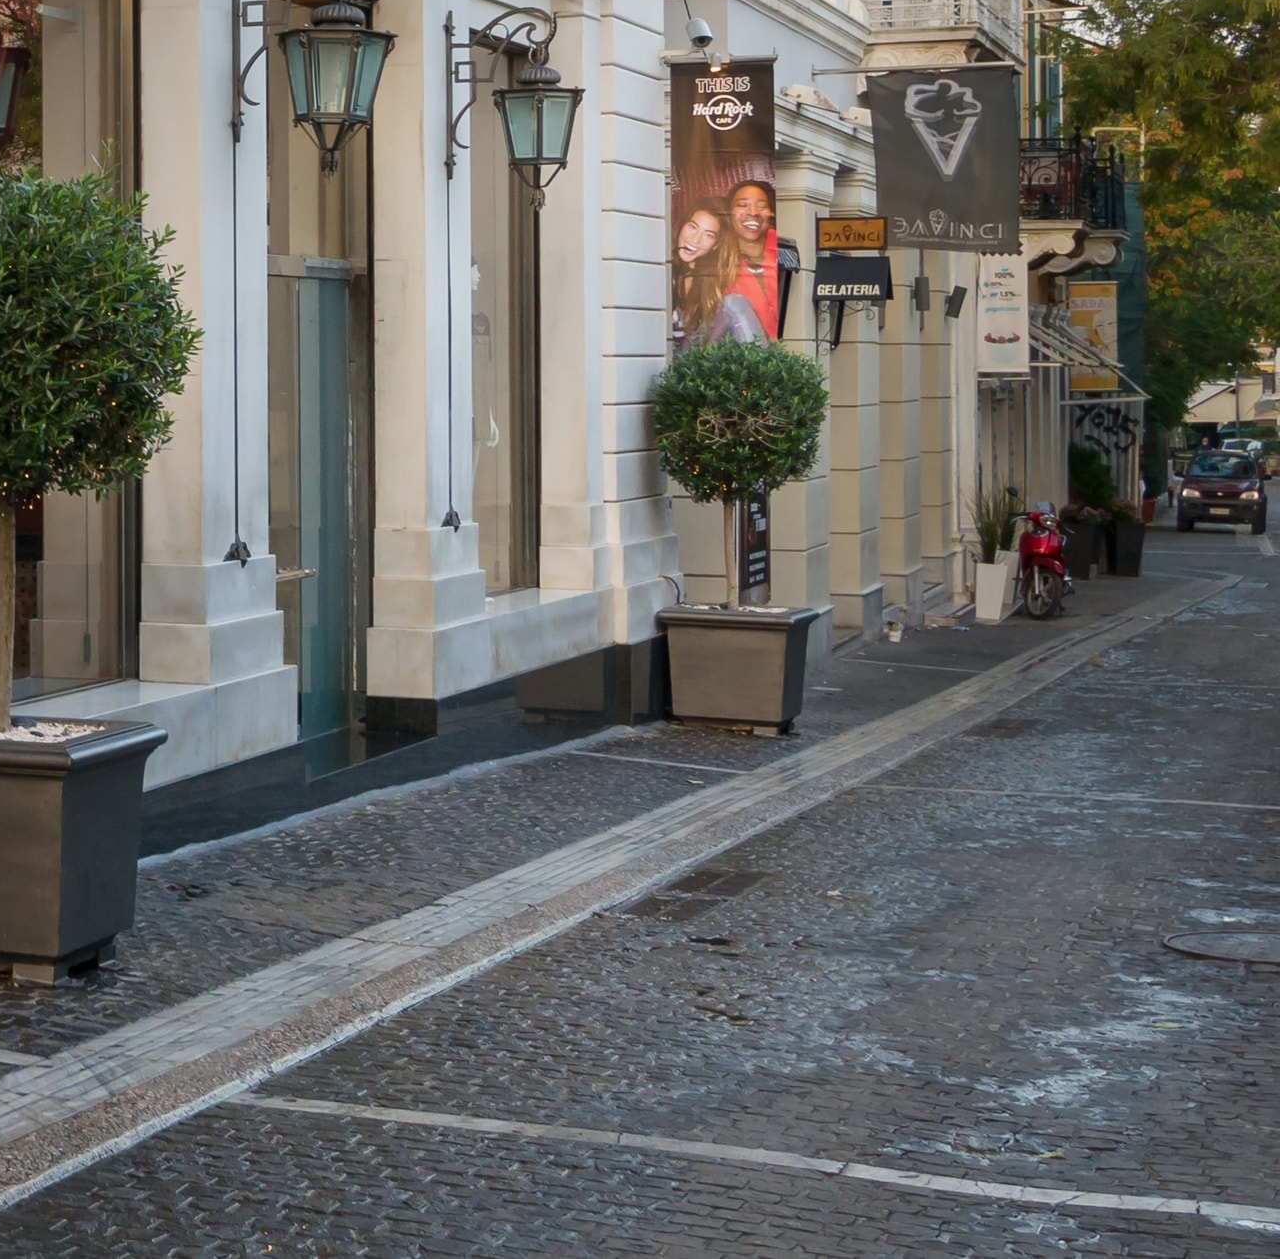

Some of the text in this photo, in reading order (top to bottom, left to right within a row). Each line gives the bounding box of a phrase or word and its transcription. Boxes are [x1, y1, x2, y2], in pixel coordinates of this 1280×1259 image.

[695, 75, 751, 94] THIS IS
[692, 101, 754, 117] Hard Rock
[893, 213, 1004, 239] DAVINCI
[823, 228, 880, 243] DAVINCI
[816, 284, 881, 296] GELATERIA
